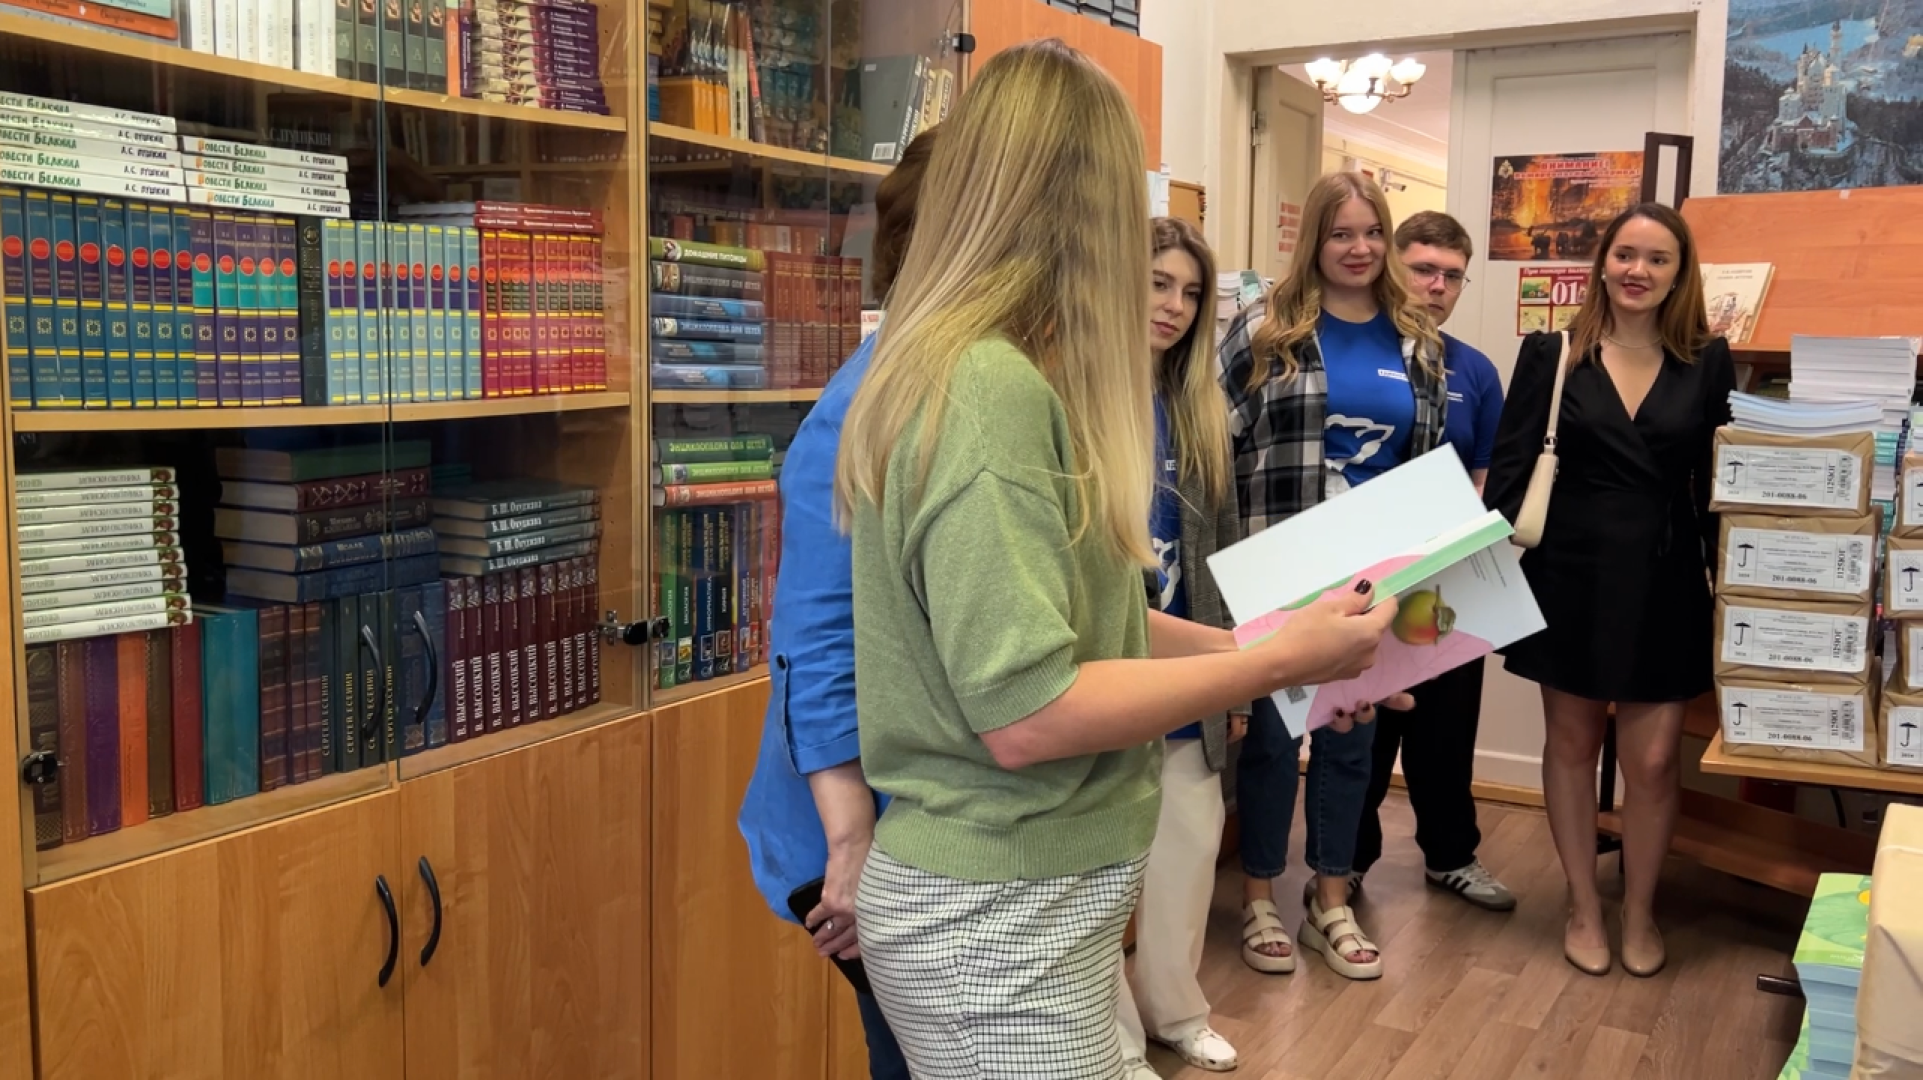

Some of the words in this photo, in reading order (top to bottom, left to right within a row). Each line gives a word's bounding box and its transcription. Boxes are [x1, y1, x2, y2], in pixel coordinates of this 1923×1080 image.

[196, 155, 229, 170] ПОВЕСТИ
[198, 138, 231, 153] ПОВЕСТИ
[37, 153, 80, 168] БЕЛКИНА
[140, 167, 169, 178] ПУШКИН
[39, 172, 81, 187] БЕЛКИНА
[141, 186, 170, 196] ПУШКИН
[198, 173, 231, 187] ПОВЕСТИ
[207, 192, 240, 204] ПОВЕСТИ
[1552, 281, 1578, 305] 01
[507, 649, 520, 710] ВЫСОЦКИЙ
[525, 644, 537, 704] ВЫСОЦКИЙ
[544, 641, 558, 701] ВЫСОЦКИЙ
[560, 637, 572, 696] ВЫСОЦКИЙ
[575, 633, 586, 691] ВЫСОЦКИЙ
[345, 672, 353, 713] ЕСЕНИН
[366, 670, 374, 709] ЕСЕНИН
[452, 659, 466, 723] ВЫСОЦКИЙ
[470, 656, 483, 718] ВЫСОЦКИЙ
[488, 651, 501, 713] ВЫСОЦКИЙ
[322, 718, 330, 756] СЕРГЕЙ
[346, 715, 354, 753] СЕРГЕЙ
[367, 712, 375, 749] СЕЙ
[386, 708, 394, 743] СЕРГЕЙ
